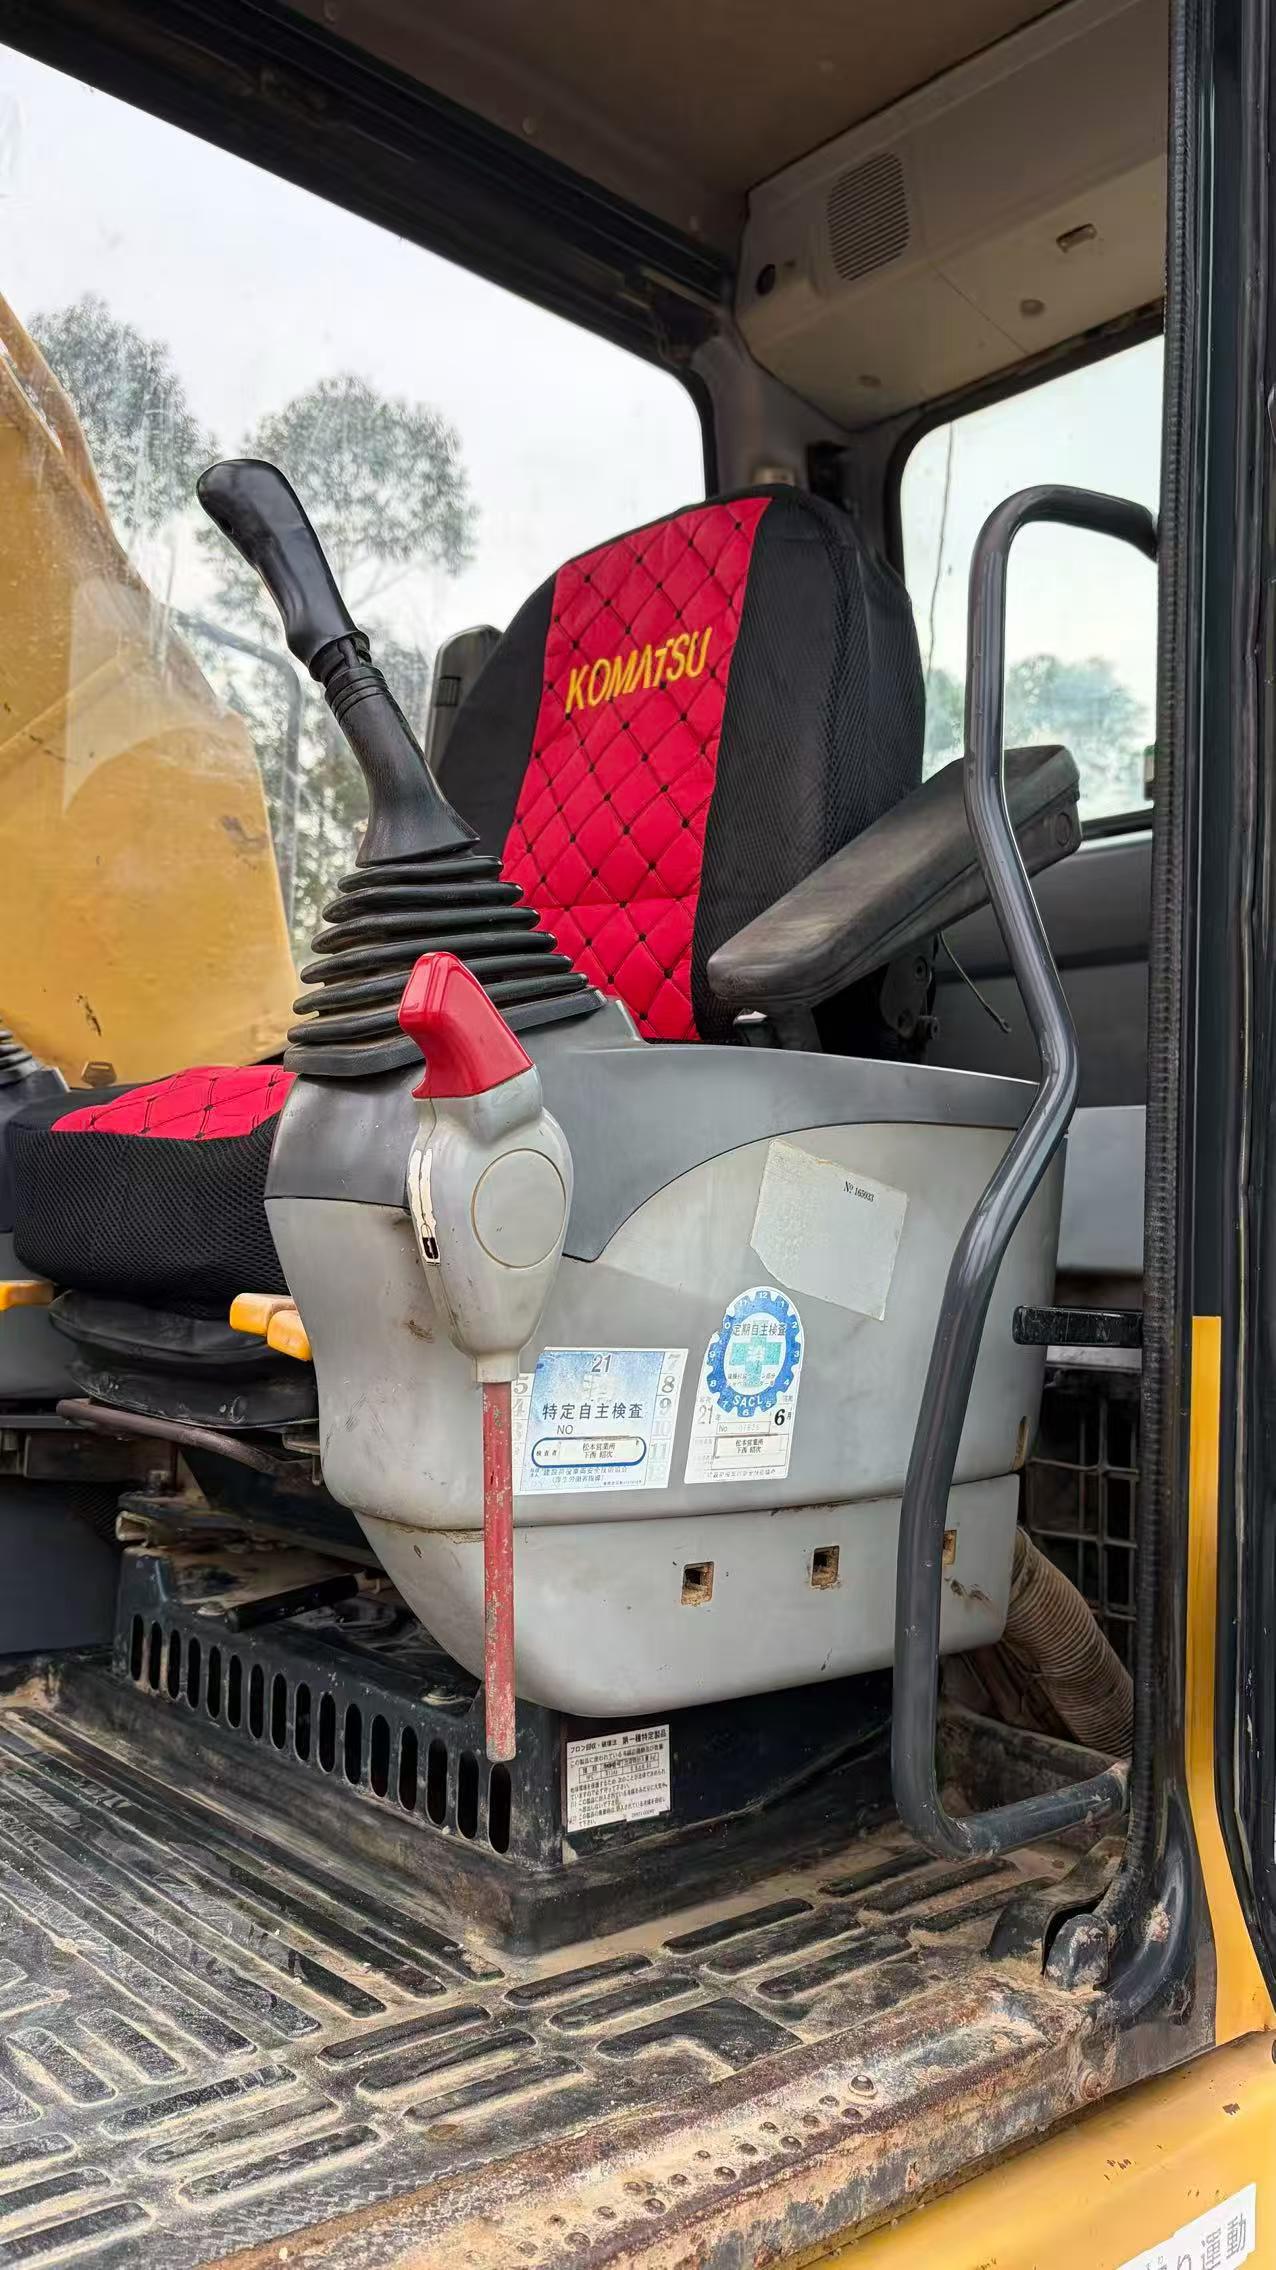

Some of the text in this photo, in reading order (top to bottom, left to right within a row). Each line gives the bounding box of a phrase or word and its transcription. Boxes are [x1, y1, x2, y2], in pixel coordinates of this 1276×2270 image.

[565, 624, 713, 713] KOMATSU
[733, 1322, 787, 1337] 定期自主検査
[791, 1321, 798, 1329] 2
[794, 1350, 800, 1358] 3
[591, 1354, 612, 1374] 21
[514, 1376, 529, 1394] 5
[661, 1375, 675, 1394] 8
[709, 1379, 717, 1388] 8
[722, 1400, 730, 1408] 7
[733, 1395, 763, 1408] SACL
[765, 1400, 772, 1408] 5
[542, 1403, 644, 1420] 特定自主検査
[697, 1405, 713, 1425] 21
[742, 1408, 750, 1416] 6
[774, 1408, 786, 1426] 6
[556, 1424, 574, 1435] NO
